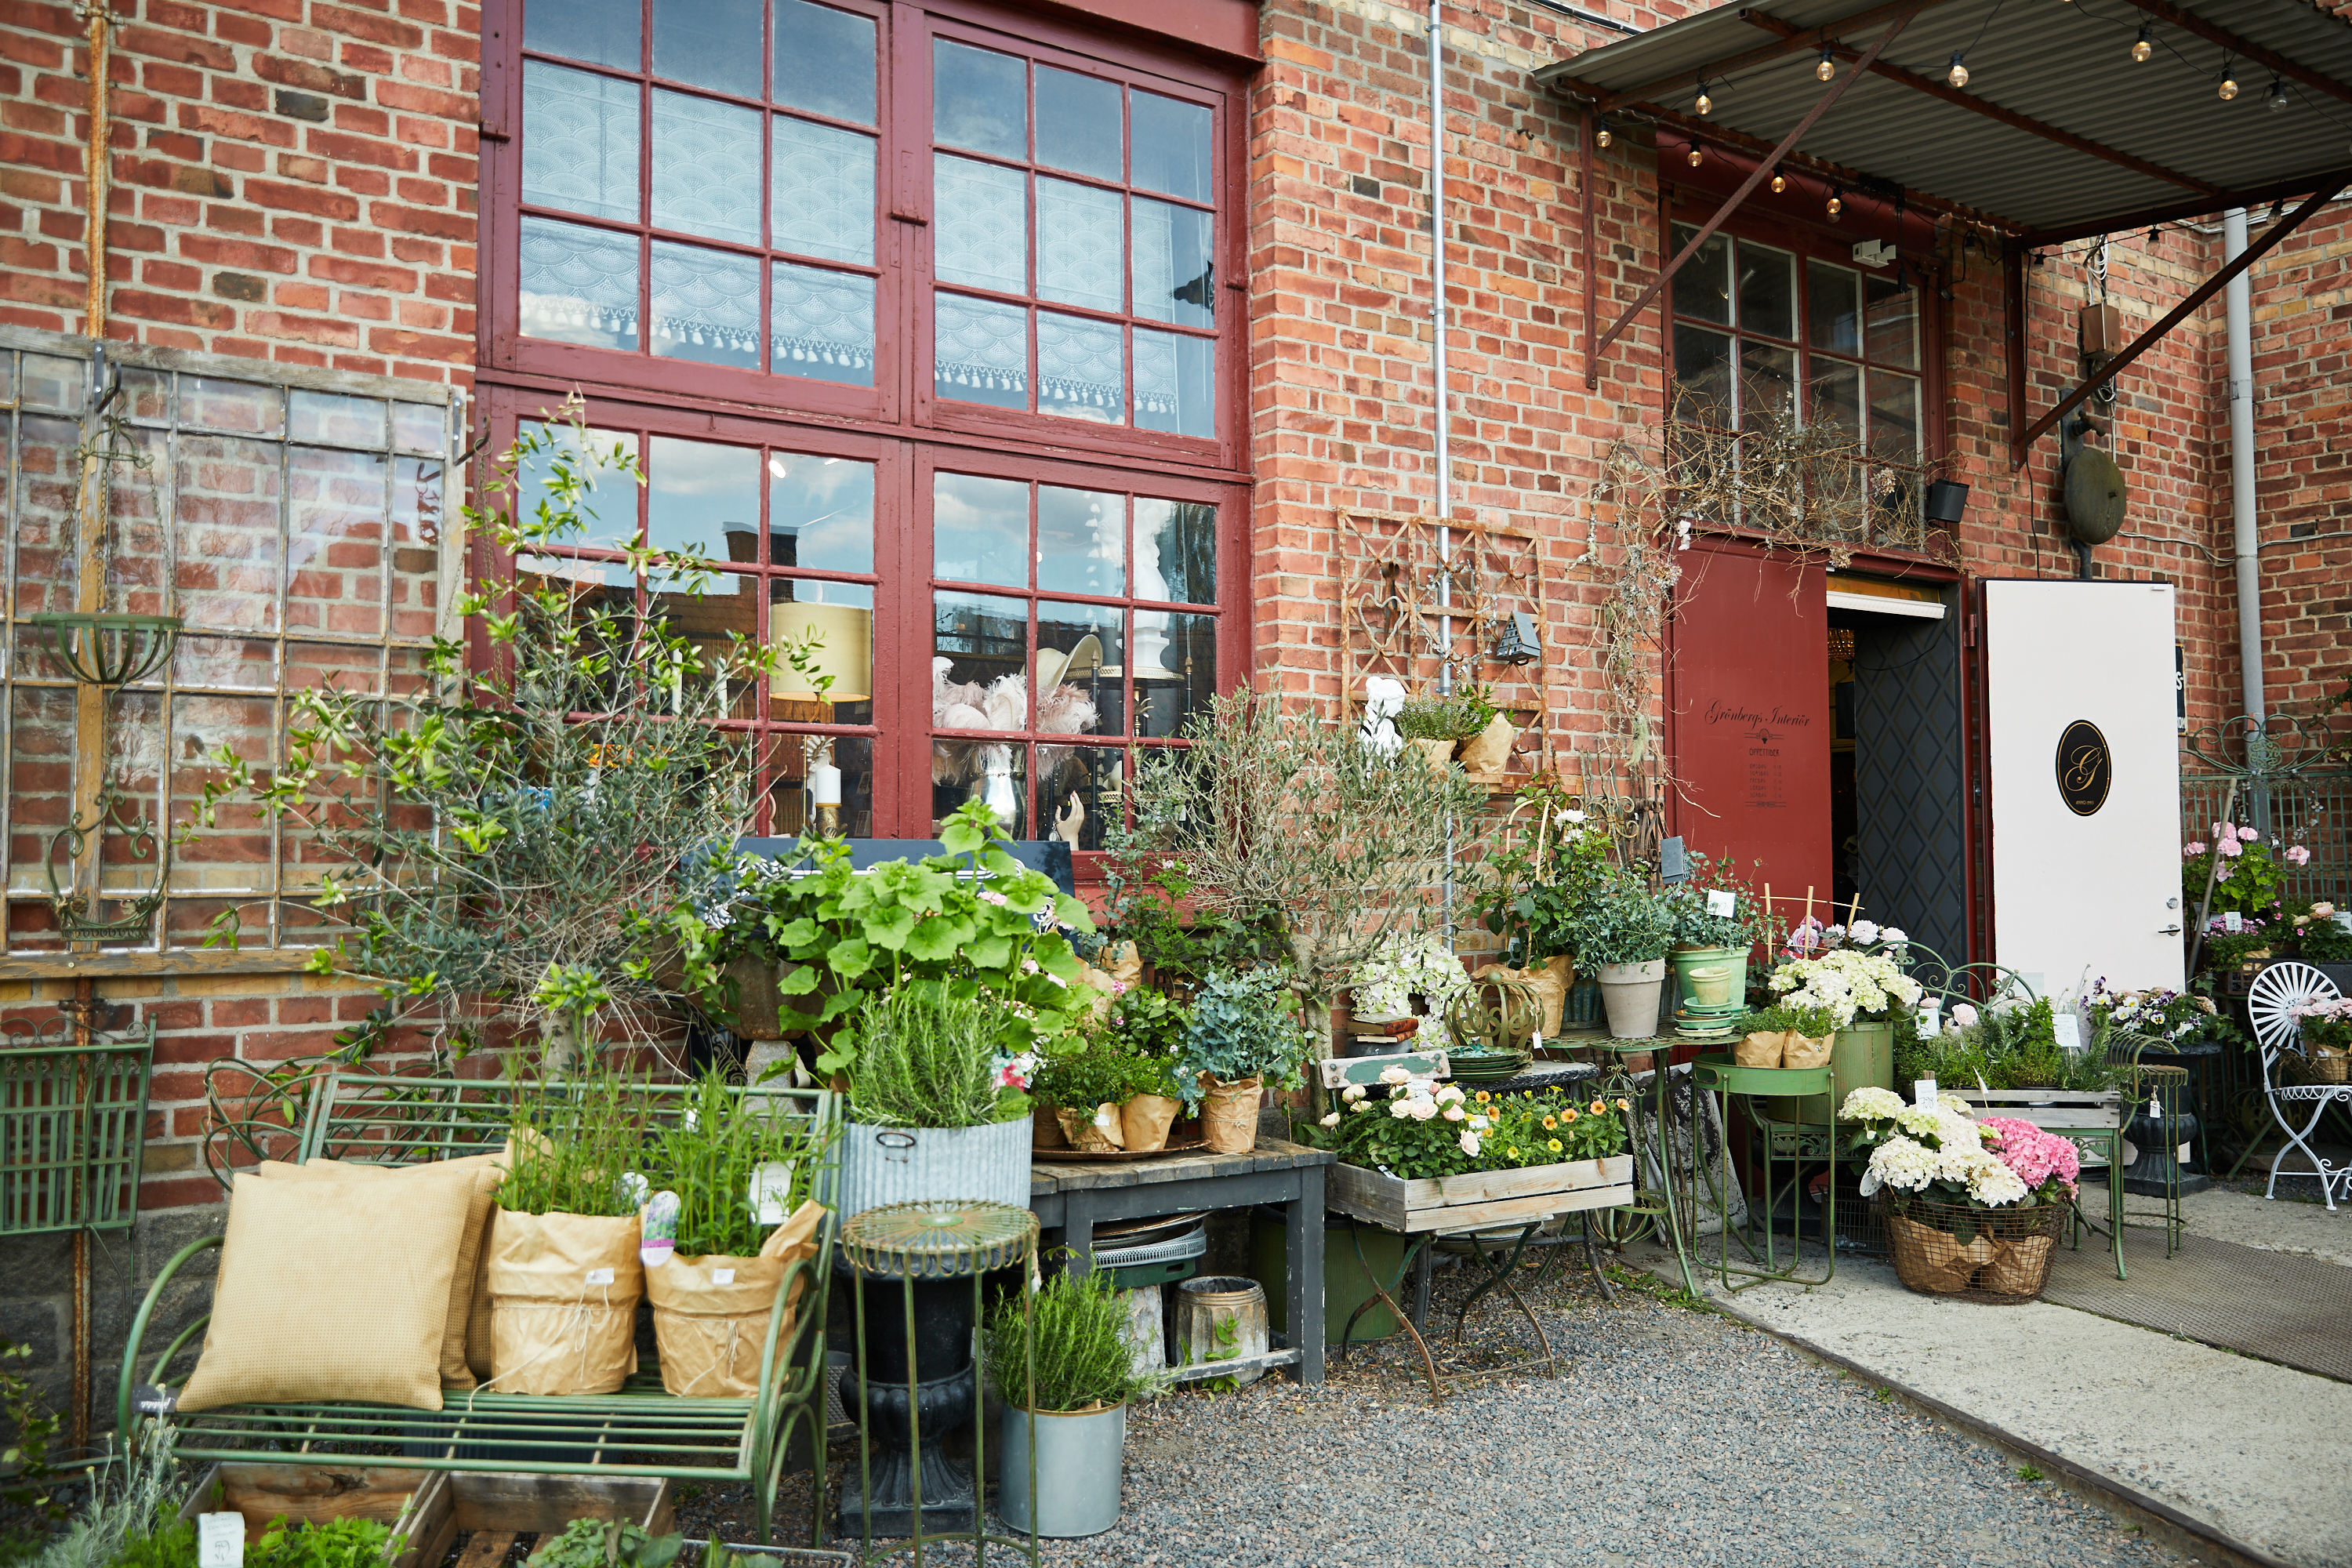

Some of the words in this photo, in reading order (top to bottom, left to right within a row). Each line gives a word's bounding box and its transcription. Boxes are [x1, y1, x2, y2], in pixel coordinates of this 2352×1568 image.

[1766, 706, 1810, 726] Interiör
[1749, 747, 1780, 757] ÖPPETTIDER
[2065, 745, 2103, 792] G
